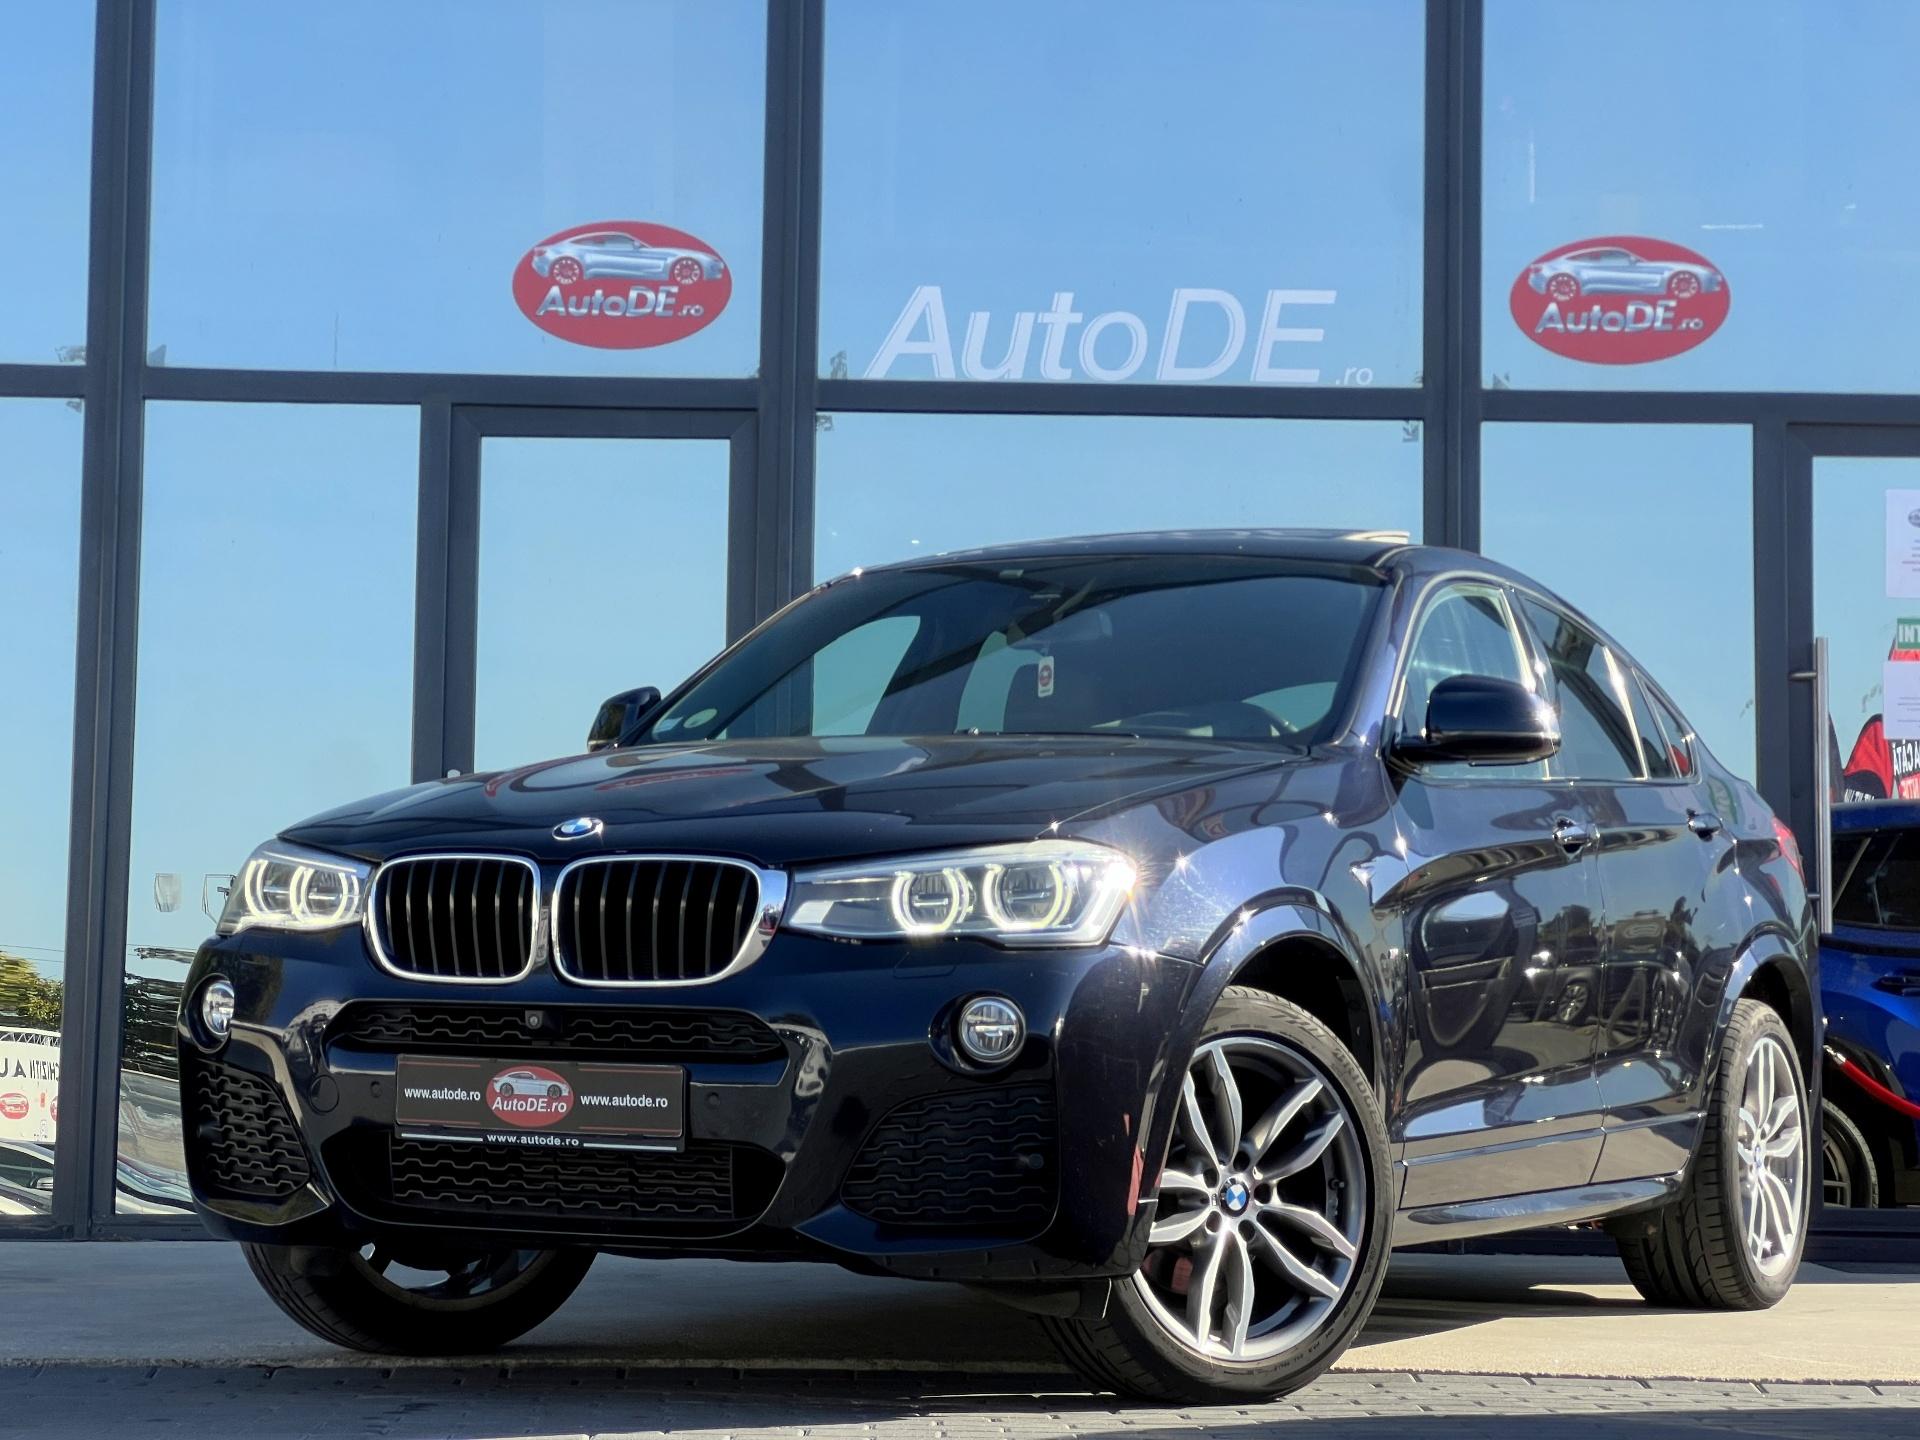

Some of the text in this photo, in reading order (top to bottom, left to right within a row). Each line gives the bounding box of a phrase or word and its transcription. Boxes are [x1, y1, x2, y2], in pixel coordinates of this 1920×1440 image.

[404, 1087, 668, 1113] www.autode.ro AutoDE.ro www.autode.ro
[487, 1133, 579, 1147] www.autode.ro
